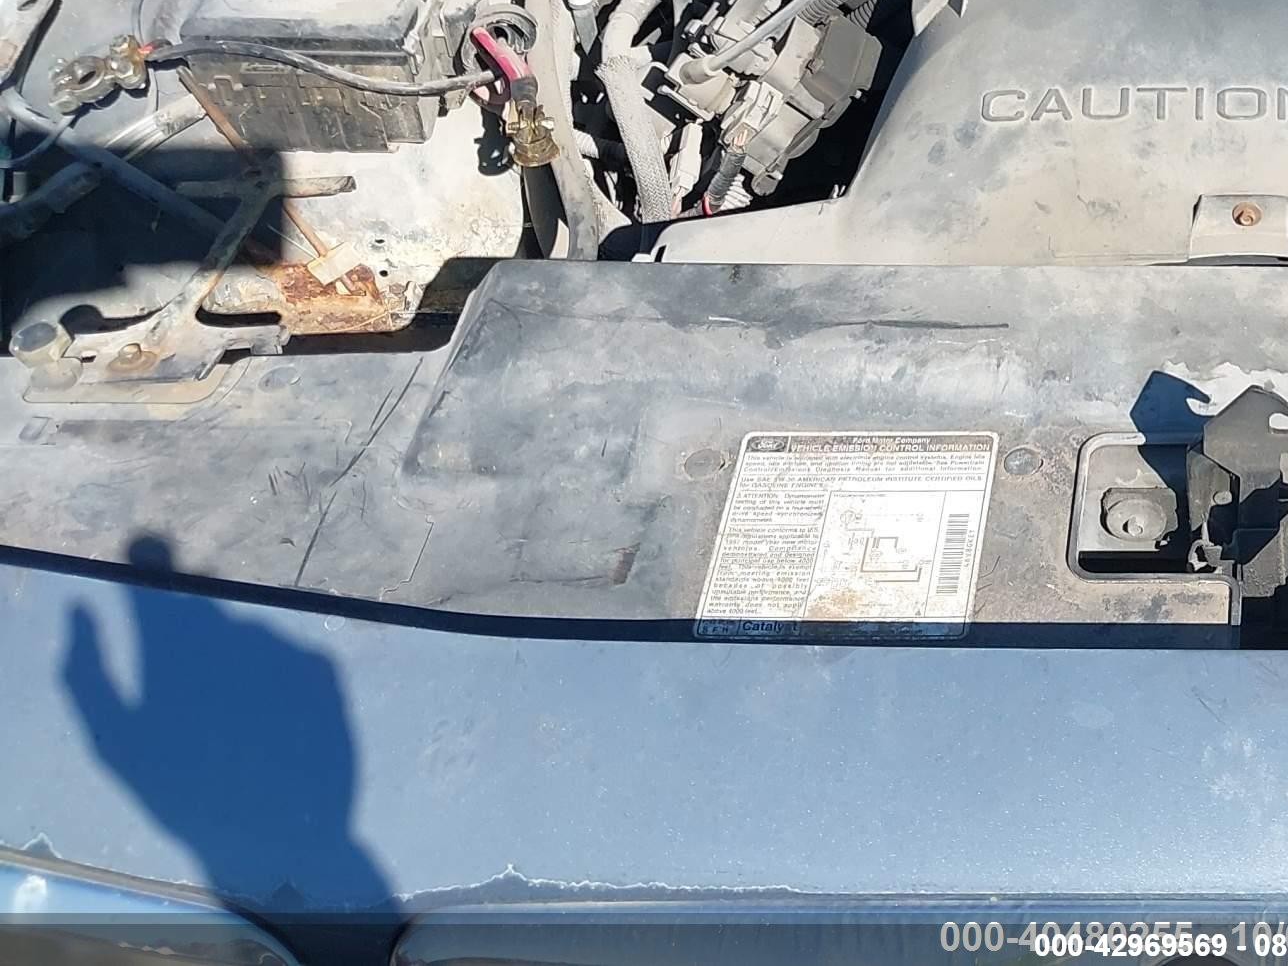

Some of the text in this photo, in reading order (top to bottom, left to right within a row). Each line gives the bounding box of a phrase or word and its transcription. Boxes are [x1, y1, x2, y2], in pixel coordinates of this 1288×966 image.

[791, 443, 990, 452] VEHICLE EMISSION CONTROL INFORMATION
[742, 620, 799, 633] Catalyt
